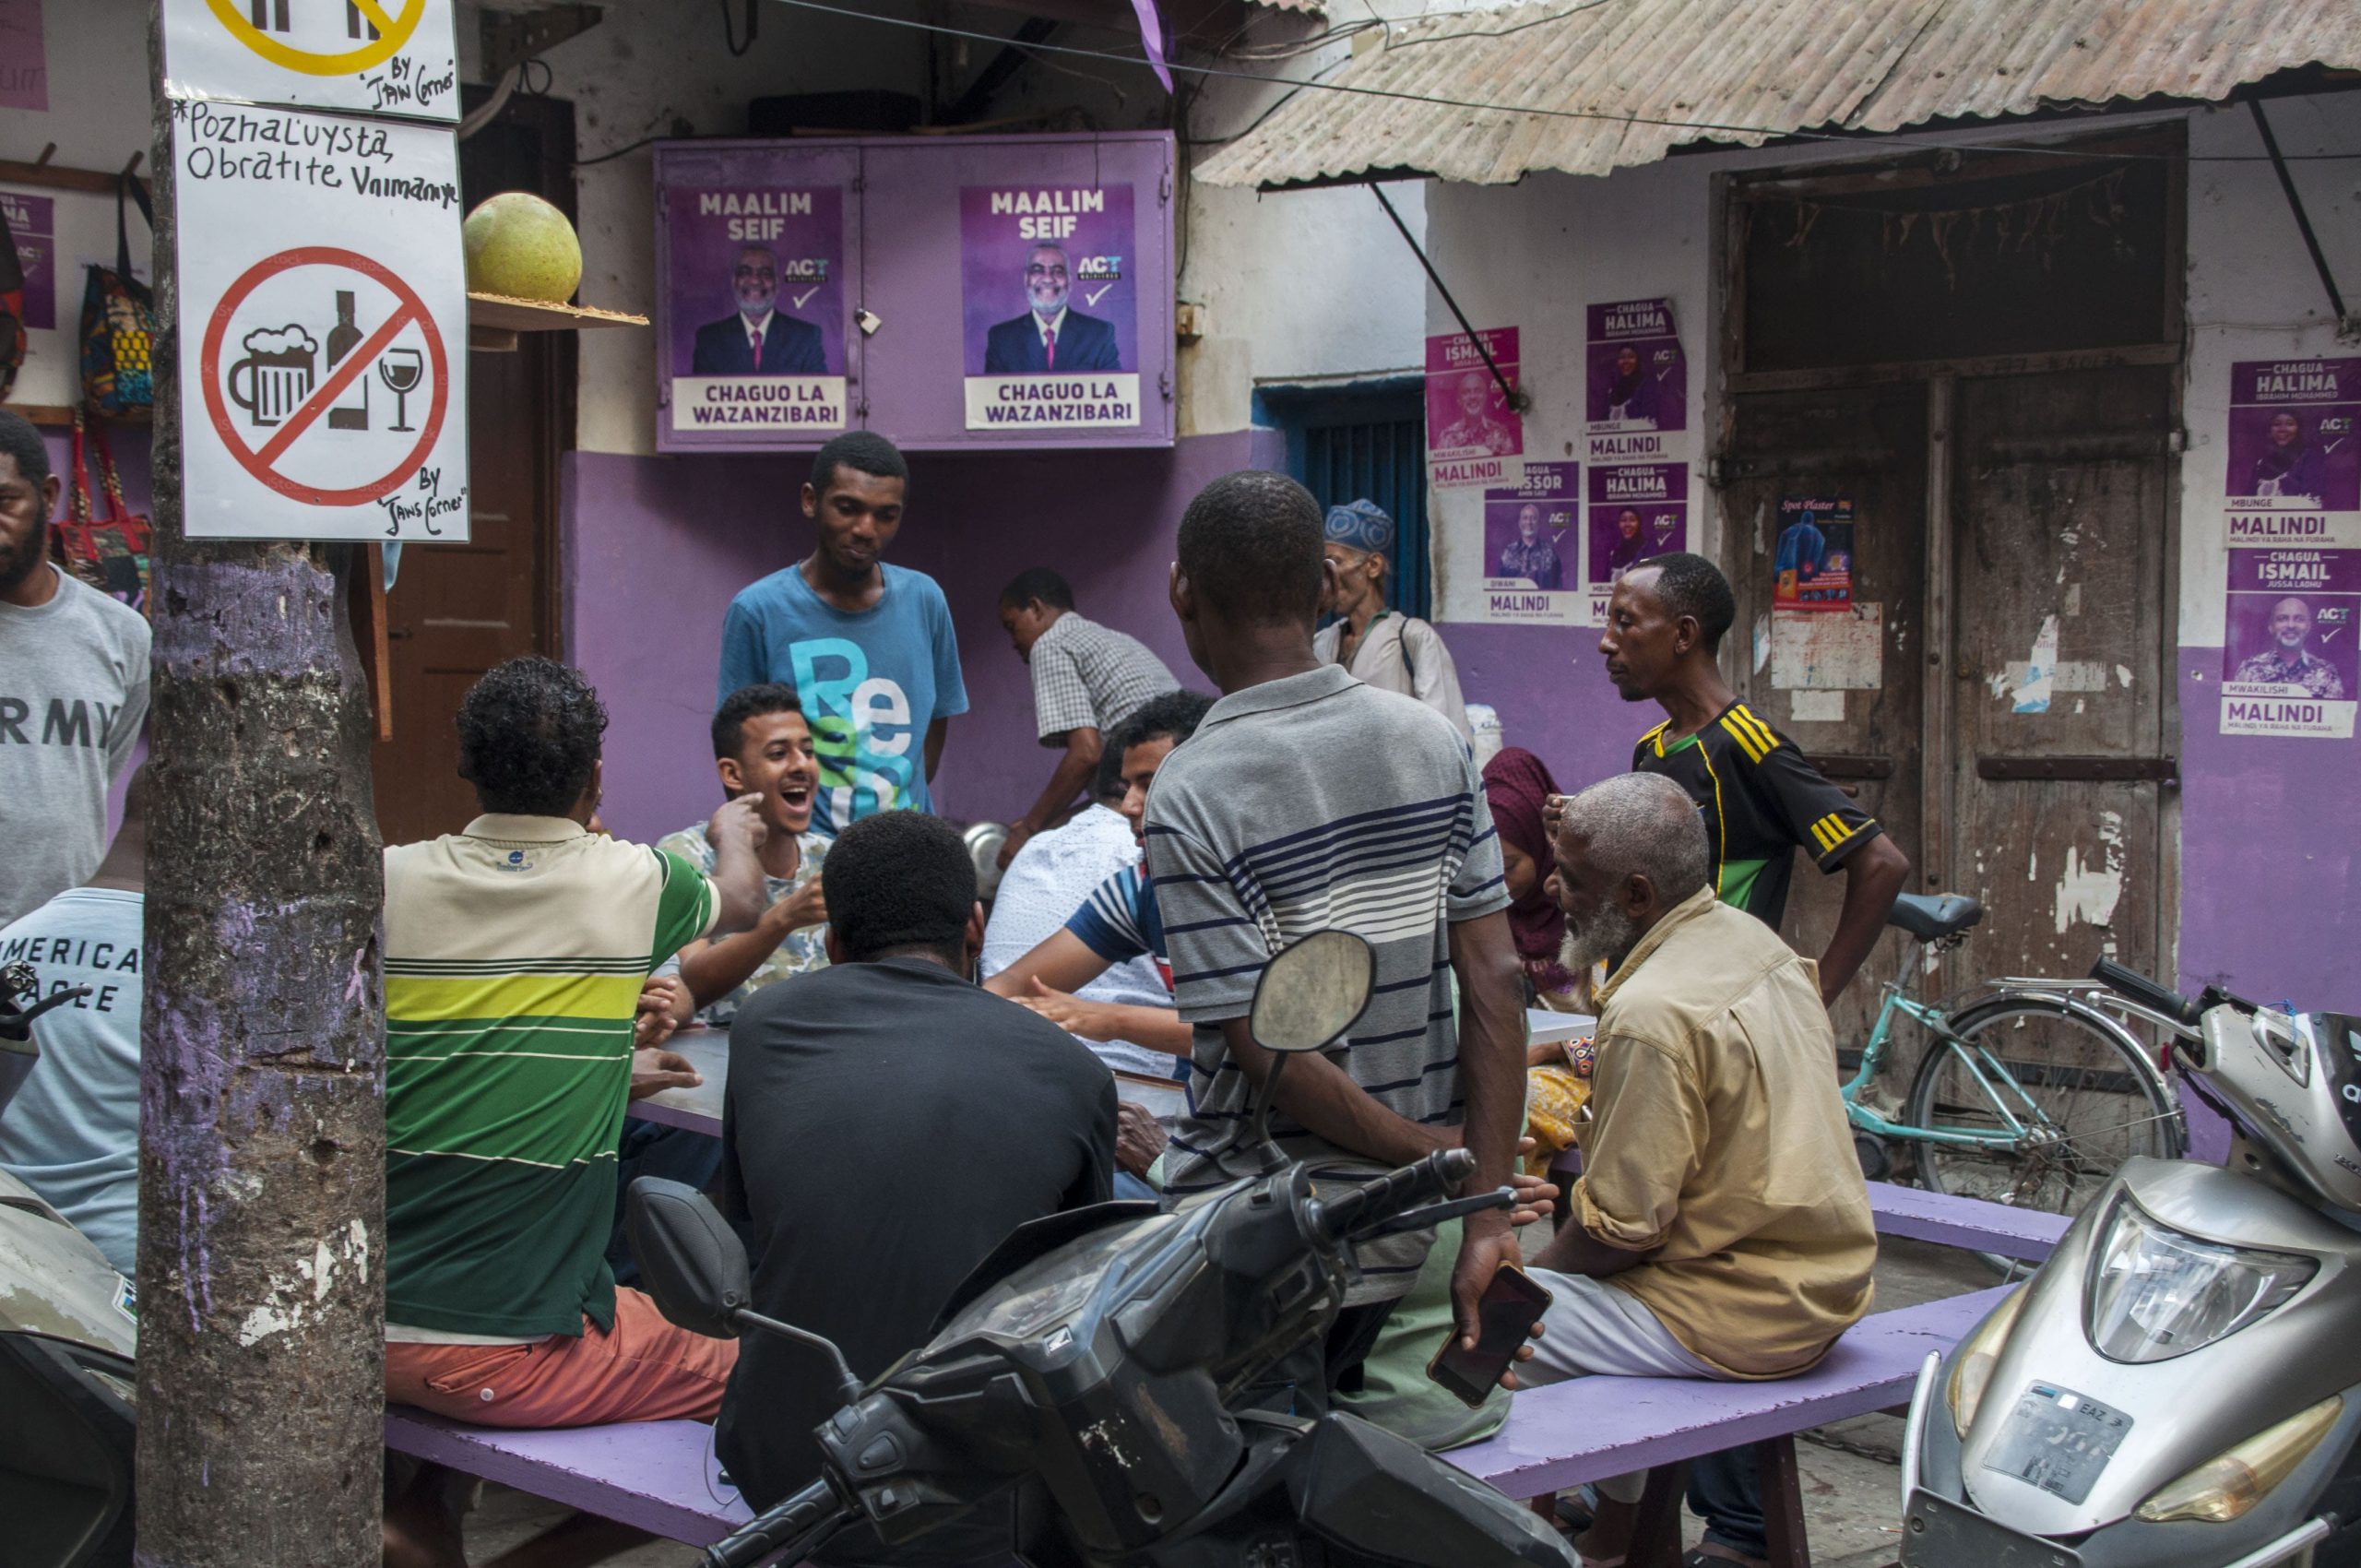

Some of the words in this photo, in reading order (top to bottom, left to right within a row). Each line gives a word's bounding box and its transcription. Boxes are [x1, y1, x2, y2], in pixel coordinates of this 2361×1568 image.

[392, 56, 411, 81] BY
[187, 147, 342, 188] Obratite
[700, 193, 813, 215] MAALIM
[991, 190, 1104, 214] MAALIM
[728, 219, 785, 241] SEIF
[1019, 216, 1077, 240] SEIF
[786, 258, 829, 276] ACT
[1077, 255, 1122, 273] ACT
[1617, 303, 1655, 315] CHAGUA
[1605, 312, 1666, 330] HALIMA
[1453, 332, 1489, 346] CHAUA
[1653, 349, 1679, 361] ACT
[2272, 362, 2324, 374] CHAGUA
[999, 383, 1084, 401] CHAGUO
[1091, 382, 1118, 399] LA
[2256, 374, 2338, 393] HALIMA
[706, 385, 790, 402] CHAGUO
[797, 385, 825, 402] LA
[693, 406, 838, 424] WAZANZIBARI
[985, 403, 1132, 423] WAZANZIBARI
[2319, 418, 2354, 431] ACT
[1591, 436, 1661, 456] MALINDI
[1434, 461, 1502, 481] MALINDI
[1525, 466, 1549, 474] AGUA
[1618, 467, 1655, 478] CHAGUA
[1509, 475, 1562, 490] SSOR
[1606, 476, 1667, 493] HALIMA
[1781, 500, 1802, 514] Spot
[1803, 499, 1835, 511] Plaster
[2231, 499, 2272, 507] MBUNGE
[1548, 512, 1572, 523] ACT
[1654, 514, 1679, 526] ACT
[2230, 517, 2326, 535] MALINDI
[2270, 552, 2321, 562] CHAGUA
[2258, 564, 2331, 580] ISMAIL
[2266, 580, 2293, 588] JUSSA
[1490, 595, 1550, 612] MALINDI
[2317, 607, 2350, 620] ACT
[2228, 684, 2288, 695] MWAKILISHI
[2228, 702, 2323, 723] MALINDI
[0, 937, 138, 974] MERICA
[2080, 1403, 2107, 1422] EAZ
